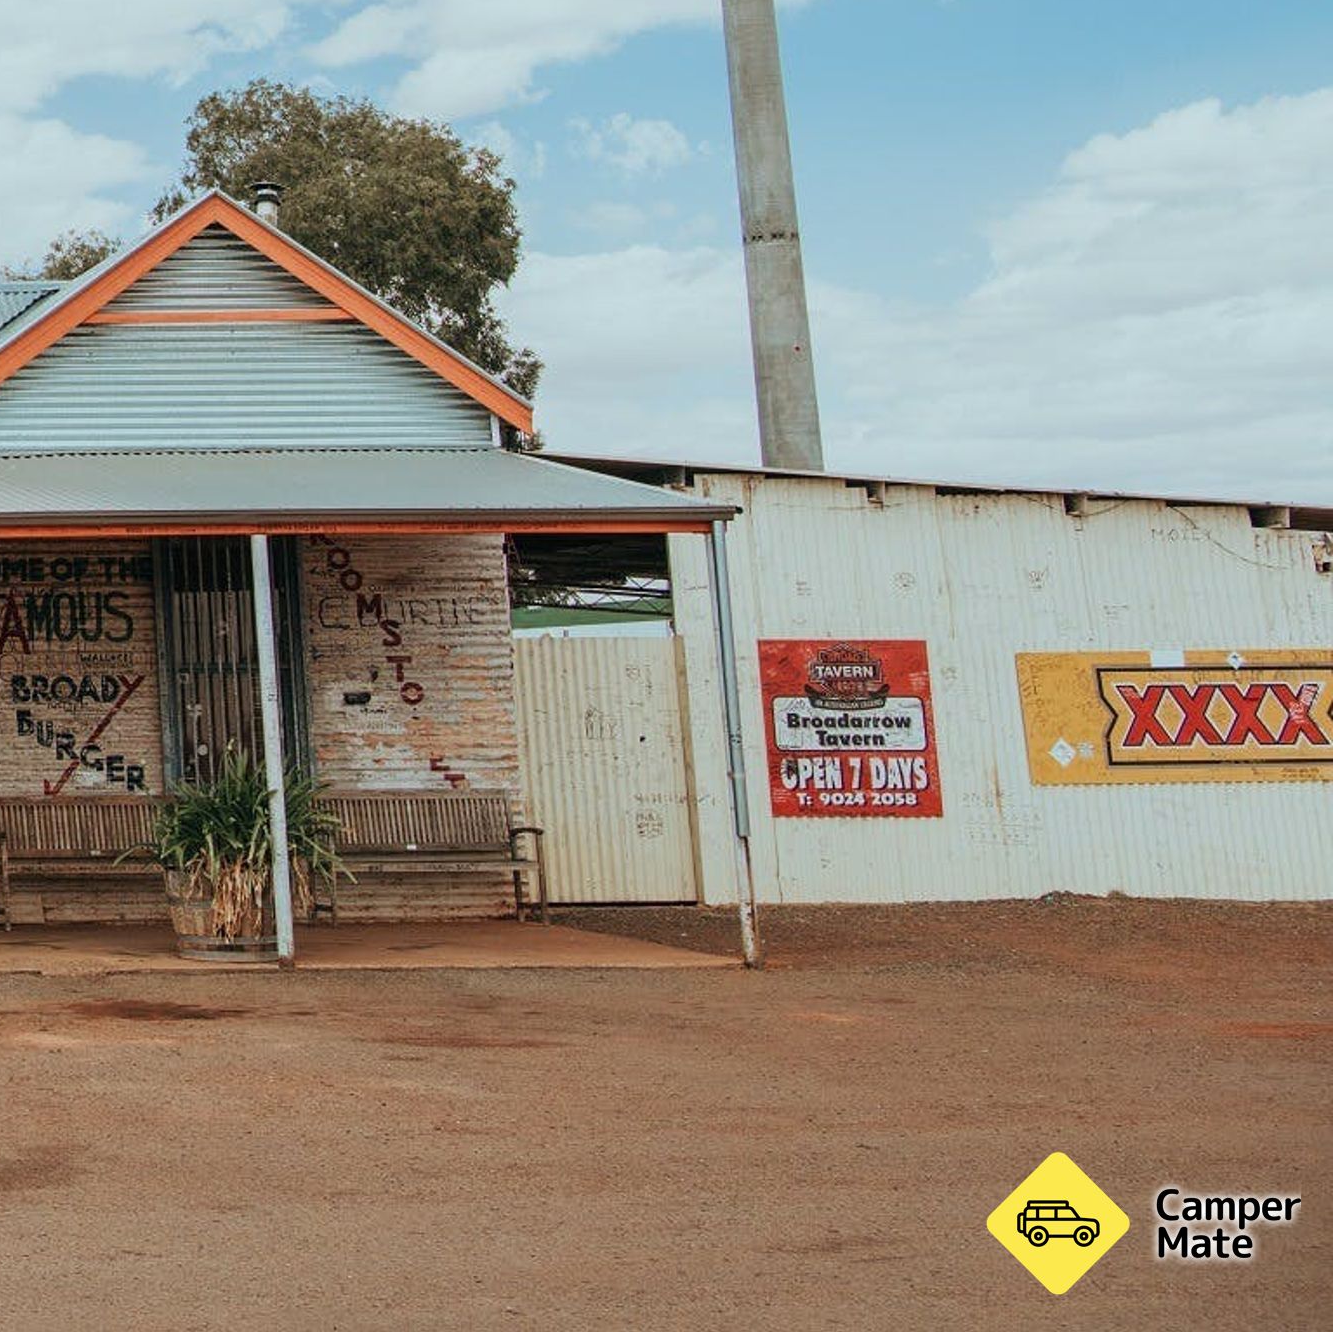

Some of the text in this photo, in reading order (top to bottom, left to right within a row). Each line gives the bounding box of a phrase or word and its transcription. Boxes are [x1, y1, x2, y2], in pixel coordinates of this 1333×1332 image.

[50, 556, 90, 582] OF
[97, 555, 156, 582] THE
[815, 666, 874, 678] TAVERN
[11, 673, 146, 703] BROADY
[786, 713, 912, 729] Broadarrow
[1114, 684, 1331, 747] XXXX
[15, 709, 145, 791] BURGER
[815, 730, 886, 746] Tavern
[780, 756, 929, 790] OPEN 7 DAYS
[797, 793, 918, 806] T: 9024 2058
